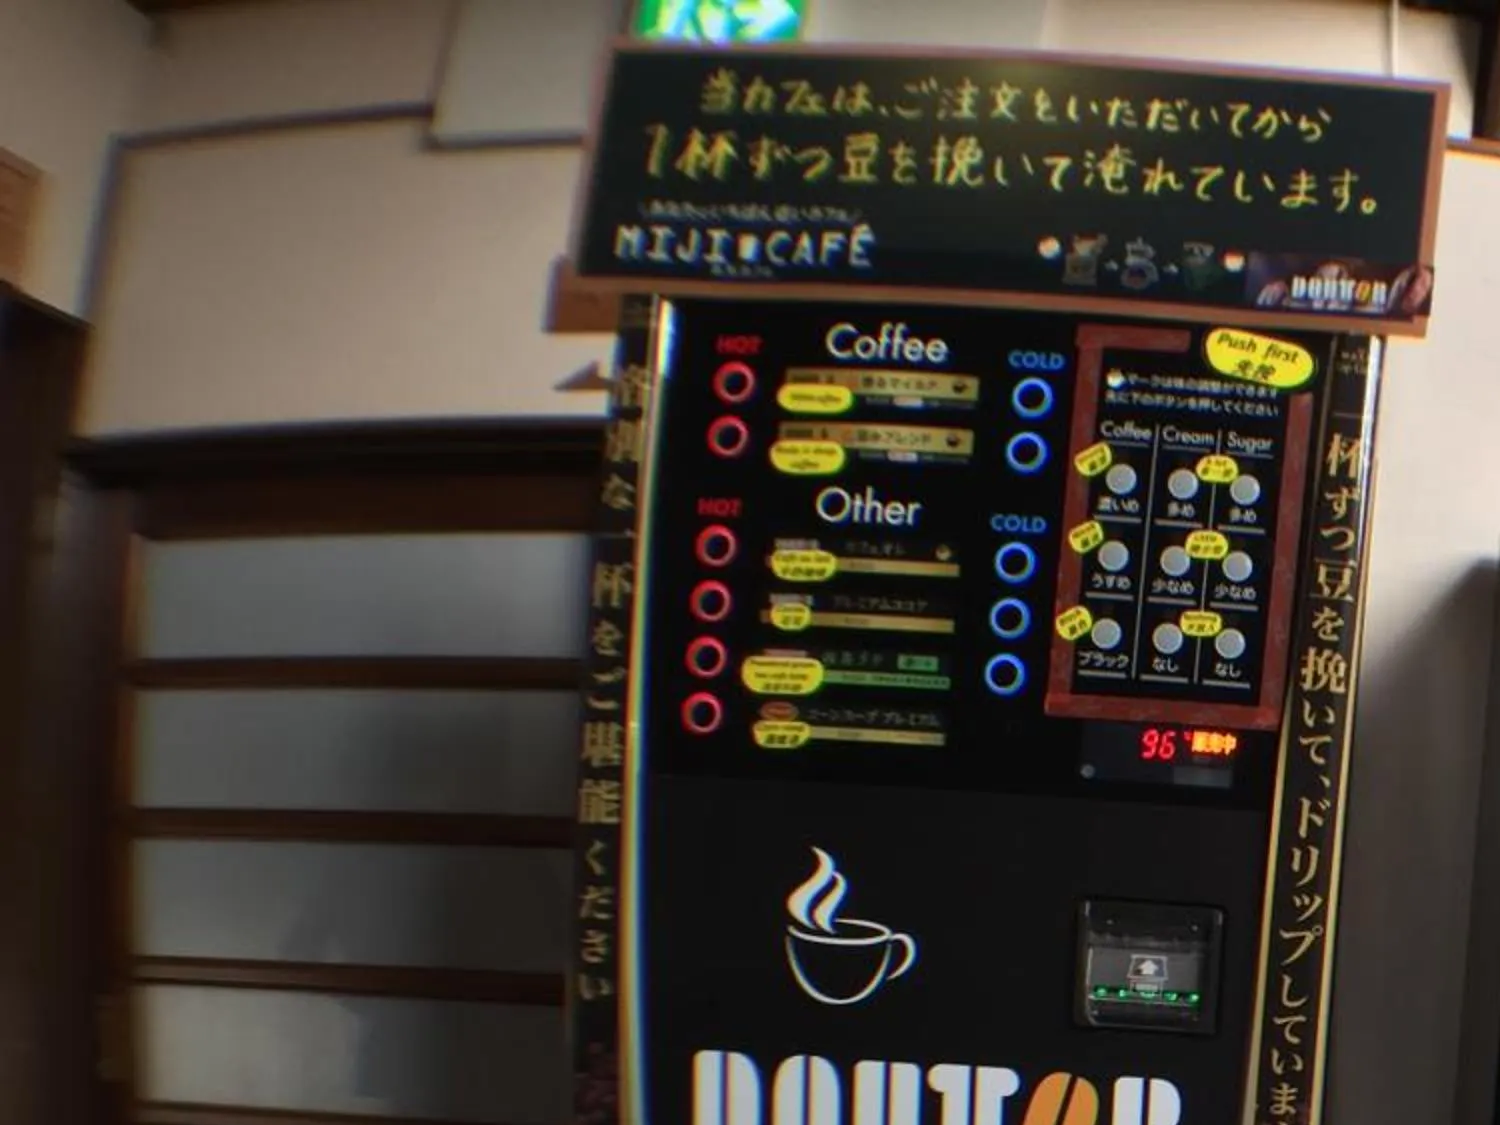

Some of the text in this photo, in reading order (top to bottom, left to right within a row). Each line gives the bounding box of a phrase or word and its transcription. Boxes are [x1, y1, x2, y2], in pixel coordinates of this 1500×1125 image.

[716, 335, 762, 354] HOT
[825, 321, 949, 363] Coffee
[1217, 331, 1299, 364] Push first
[1007, 350, 1065, 371] COLD
[1100, 420, 1153, 441] Coffee
[1163, 426, 1215, 446] Cream
[1226, 432, 1275, 453] Sugar
[697, 499, 743, 517] HOT
[815, 486, 921, 527] Other
[990, 514, 1047, 534] COLD
[1078, 650, 1129, 668] ブラック
[1152, 657, 1179, 673] なし
[1216, 662, 1241, 678] なし
[1141, 728, 1177, 760] 96
